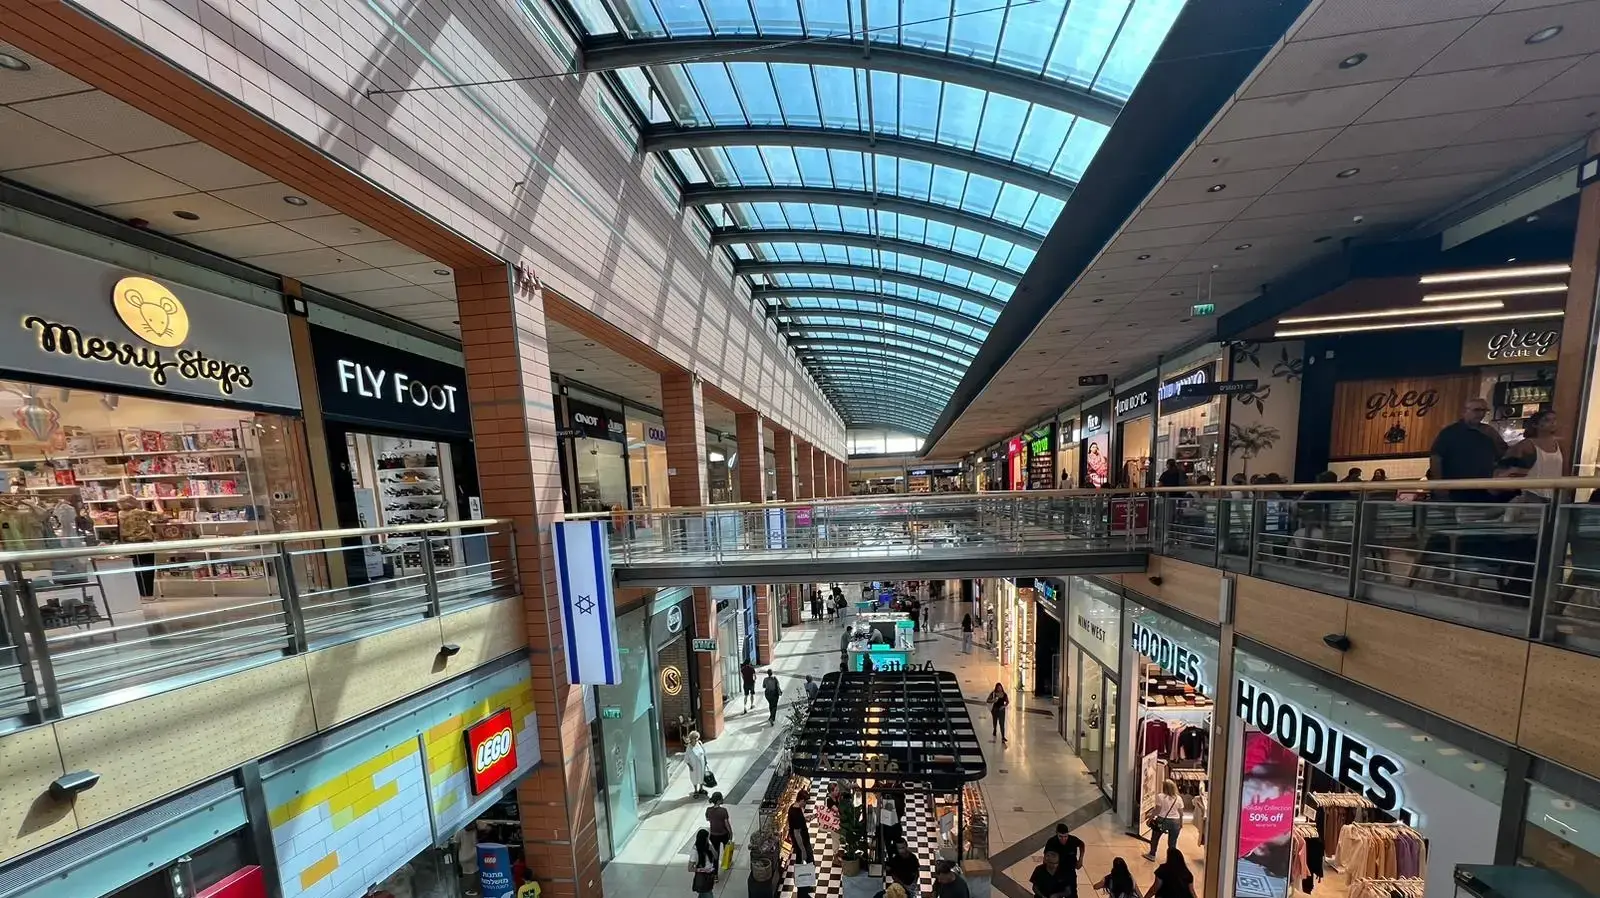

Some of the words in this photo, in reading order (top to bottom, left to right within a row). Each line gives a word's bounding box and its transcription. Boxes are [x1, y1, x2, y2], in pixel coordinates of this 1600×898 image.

[25, 316, 178, 386] Merry
[178, 349, 254, 395] Steps
[1487, 328, 1559, 360] greg
[338, 359, 386, 399] FLY
[394, 372, 457, 413] FOOT
[1365, 388, 1440, 420] greg
[574, 412, 599, 427] ONOT
[1078, 614, 1090, 633] NINE
[1091, 622, 1106, 643] WEST
[1131, 621, 1204, 693] HOODIES.
[476, 729, 513, 772] LEGO
[1236, 678, 1412, 826] HOODIES.
[1249, 813, 1269, 822] 50%
[1270, 812, 1284, 822] off
